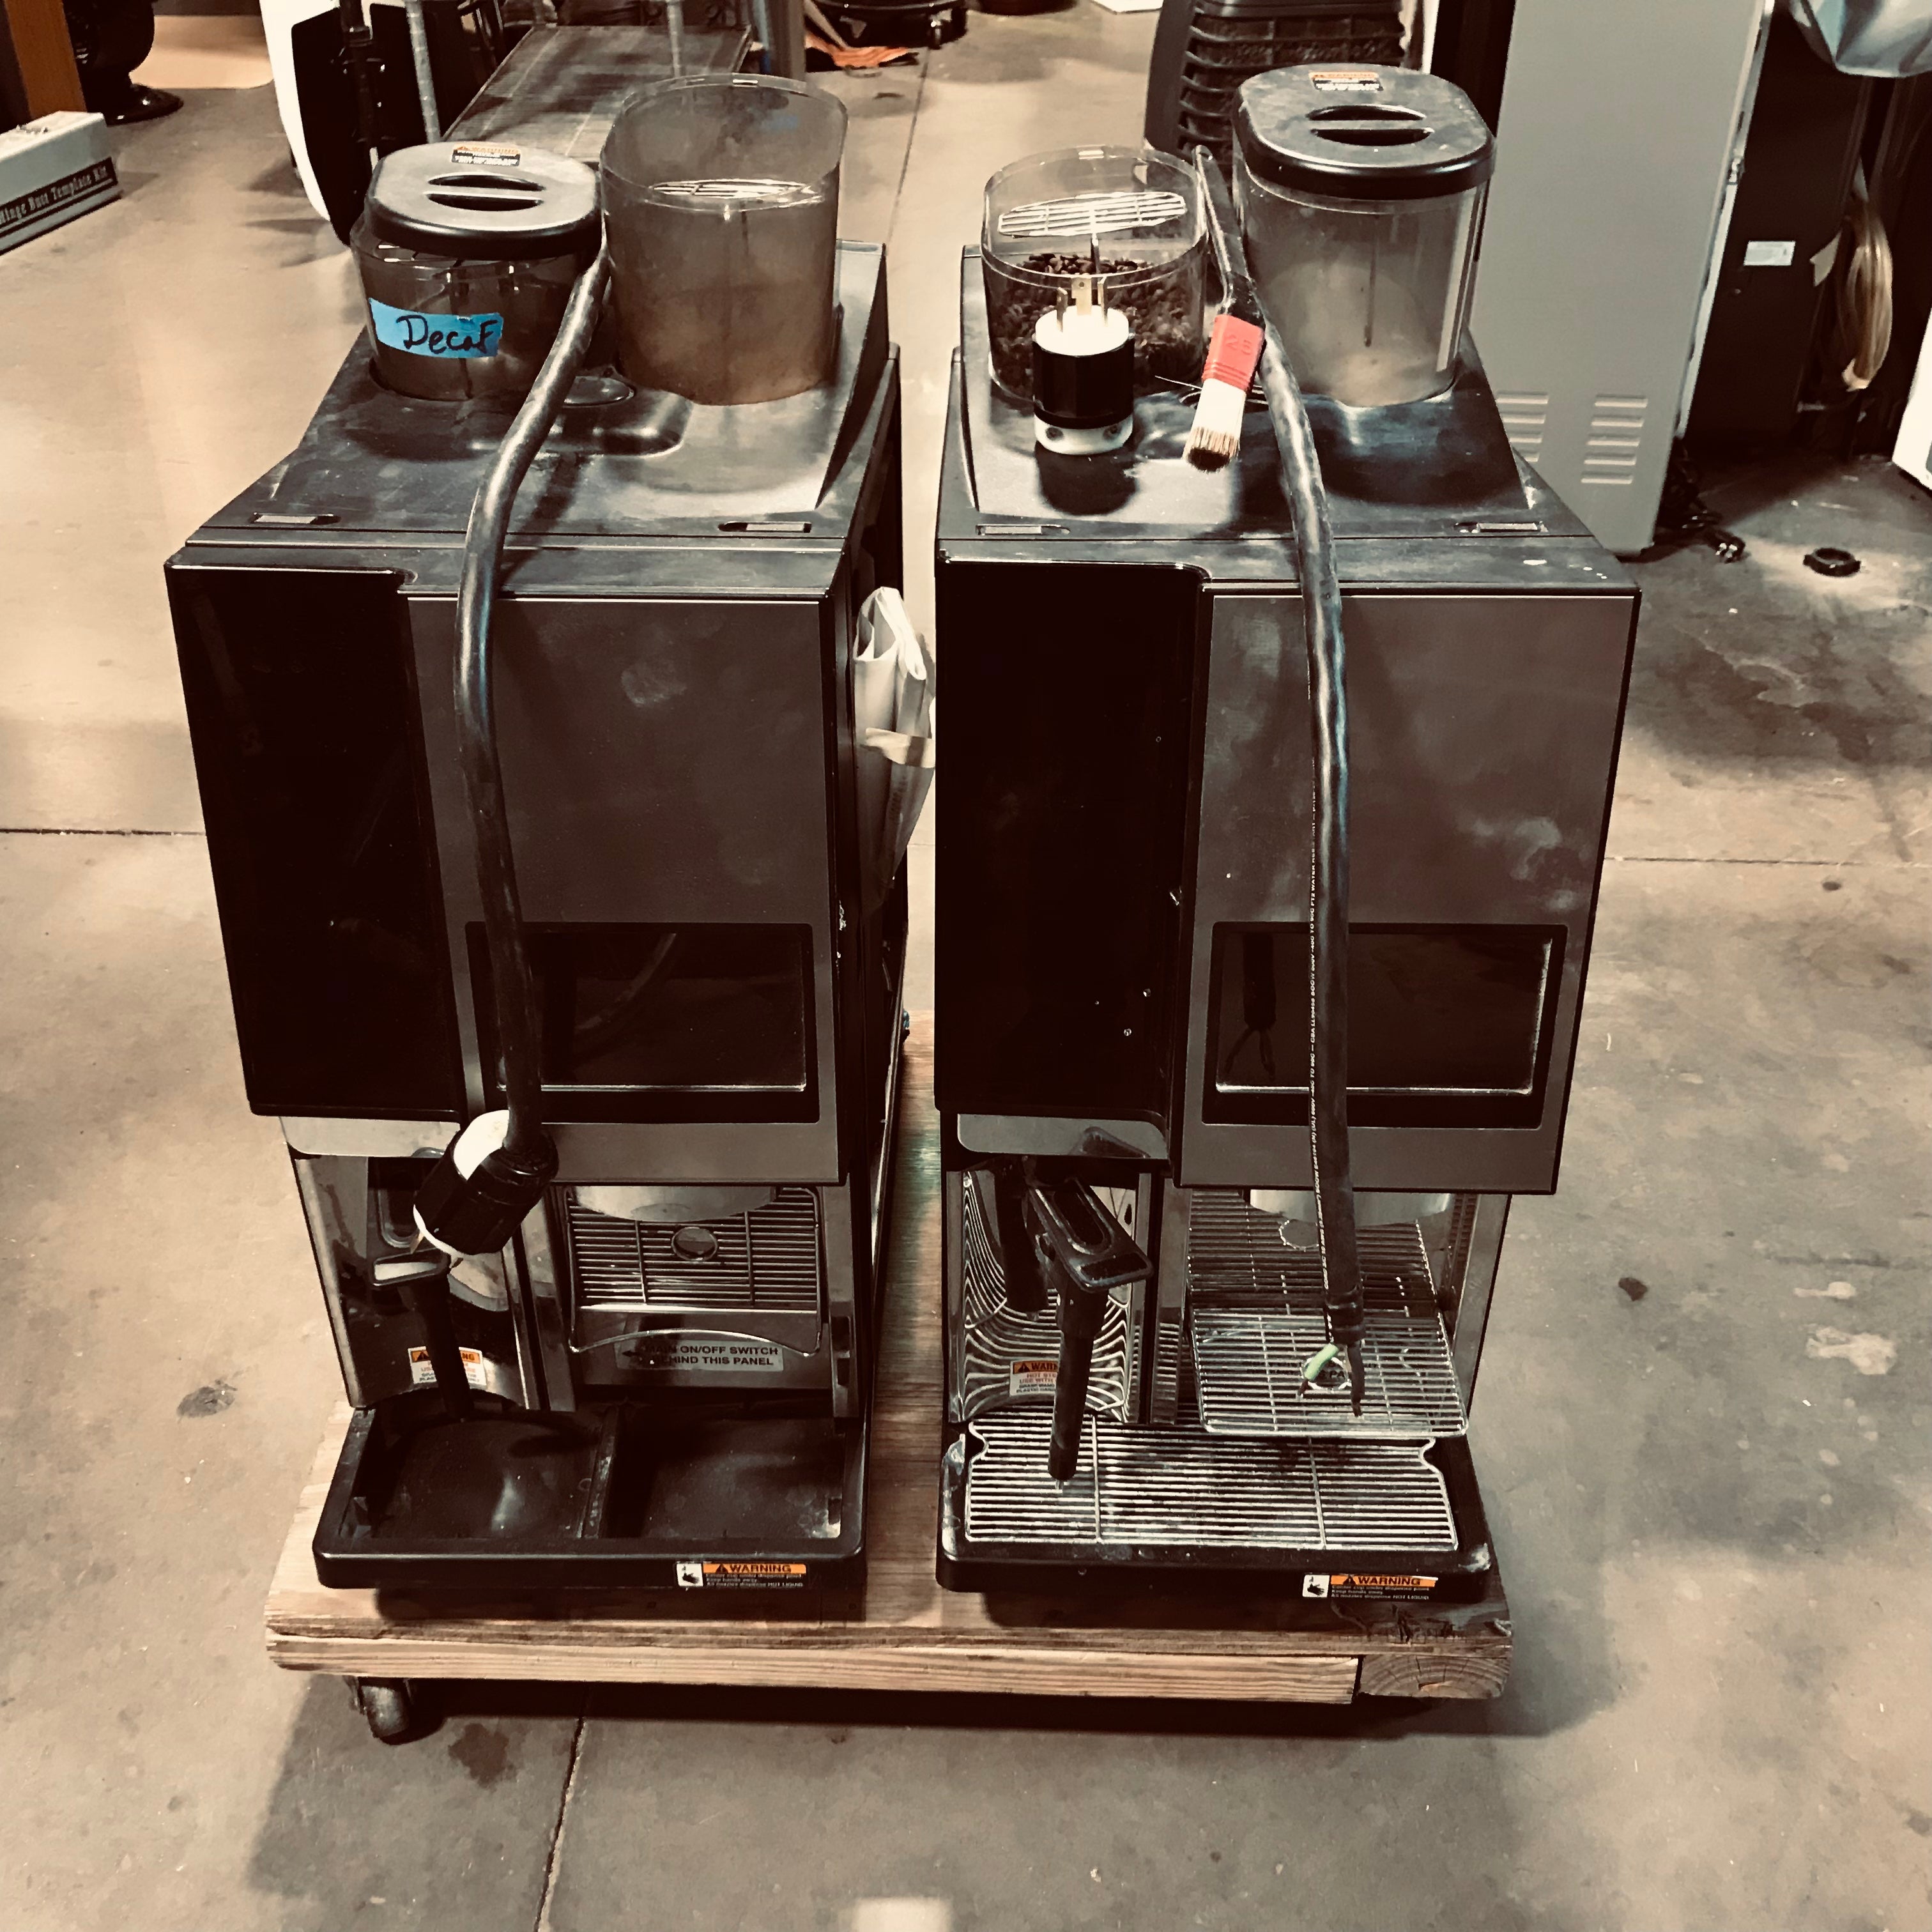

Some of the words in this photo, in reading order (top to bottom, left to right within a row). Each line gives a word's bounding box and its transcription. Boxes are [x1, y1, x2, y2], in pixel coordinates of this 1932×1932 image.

[1225, 334, 1254, 356] 25
[680, 1345, 726, 1354] ON/OFF
[729, 1346, 778, 1355] SWITCH
[702, 1356, 730, 1365] THIS
[733, 1357, 774, 1365] PANEL
[1031, 1362, 1058, 1370] WARN
[730, 1564, 792, 1572] WARNING
[1358, 1576, 1421, 1586] WARNING
